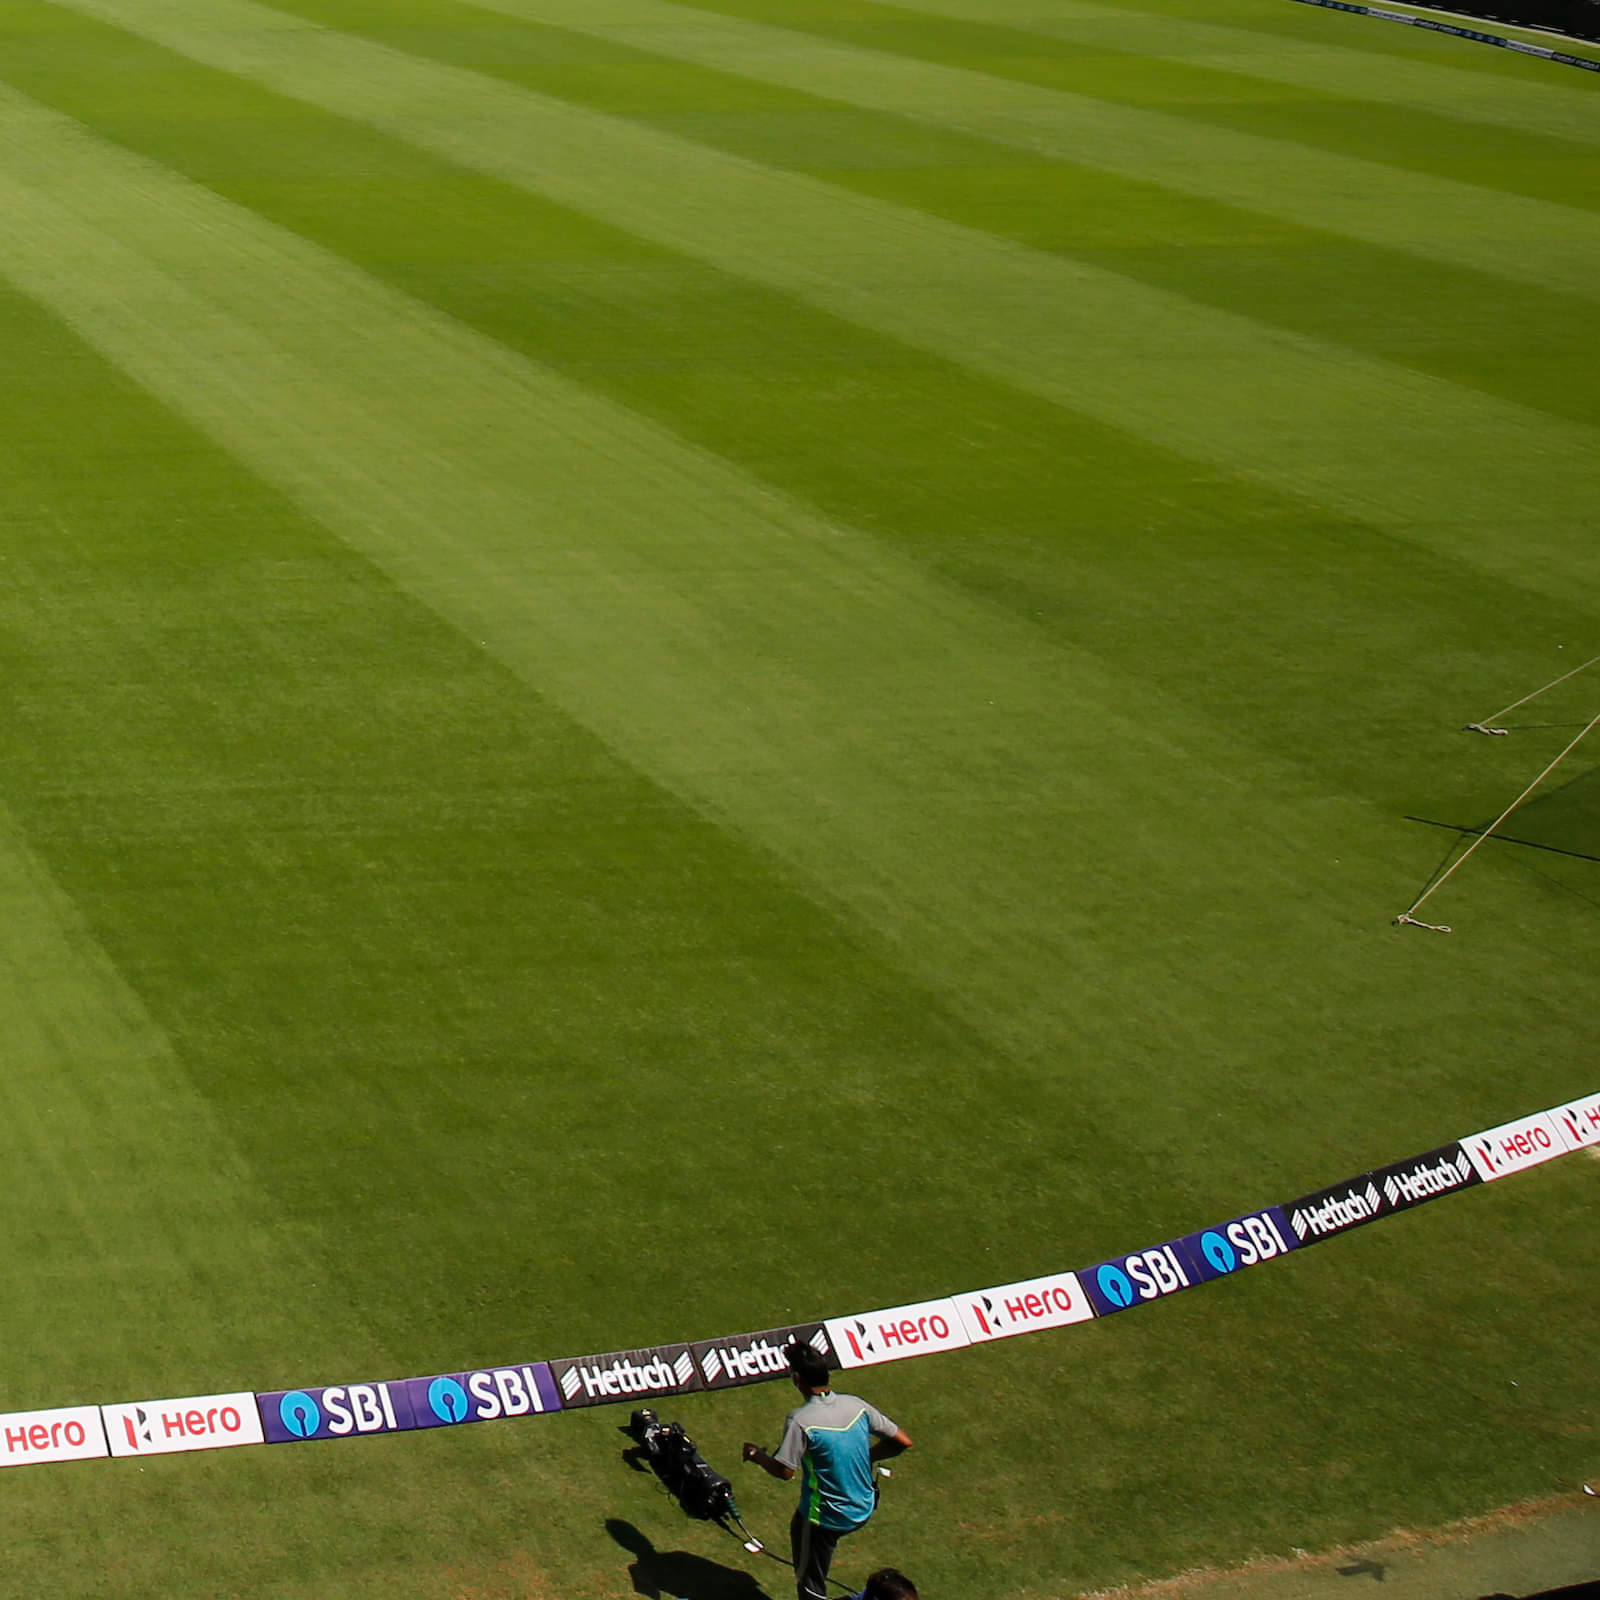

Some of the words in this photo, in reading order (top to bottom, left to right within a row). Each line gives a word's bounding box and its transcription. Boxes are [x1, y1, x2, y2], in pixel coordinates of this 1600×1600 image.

[1503, 1124, 1553, 1162] Hero
[1397, 1156, 1463, 1202] Hettich
[1305, 1187, 1374, 1236] Hettich
[1226, 1213, 1289, 1266] SBI
[1124, 1245, 1191, 1300] SBI
[1003, 1286, 1074, 1322] Hero
[878, 1313, 950, 1349] Hero
[468, 1366, 546, 1420] SBI
[582, 1351, 678, 1398] Hettich
[161, 1405, 242, 1439] Hero
[320, 1382, 400, 1435] SBI
[4, 1419, 87, 1453] Hero
